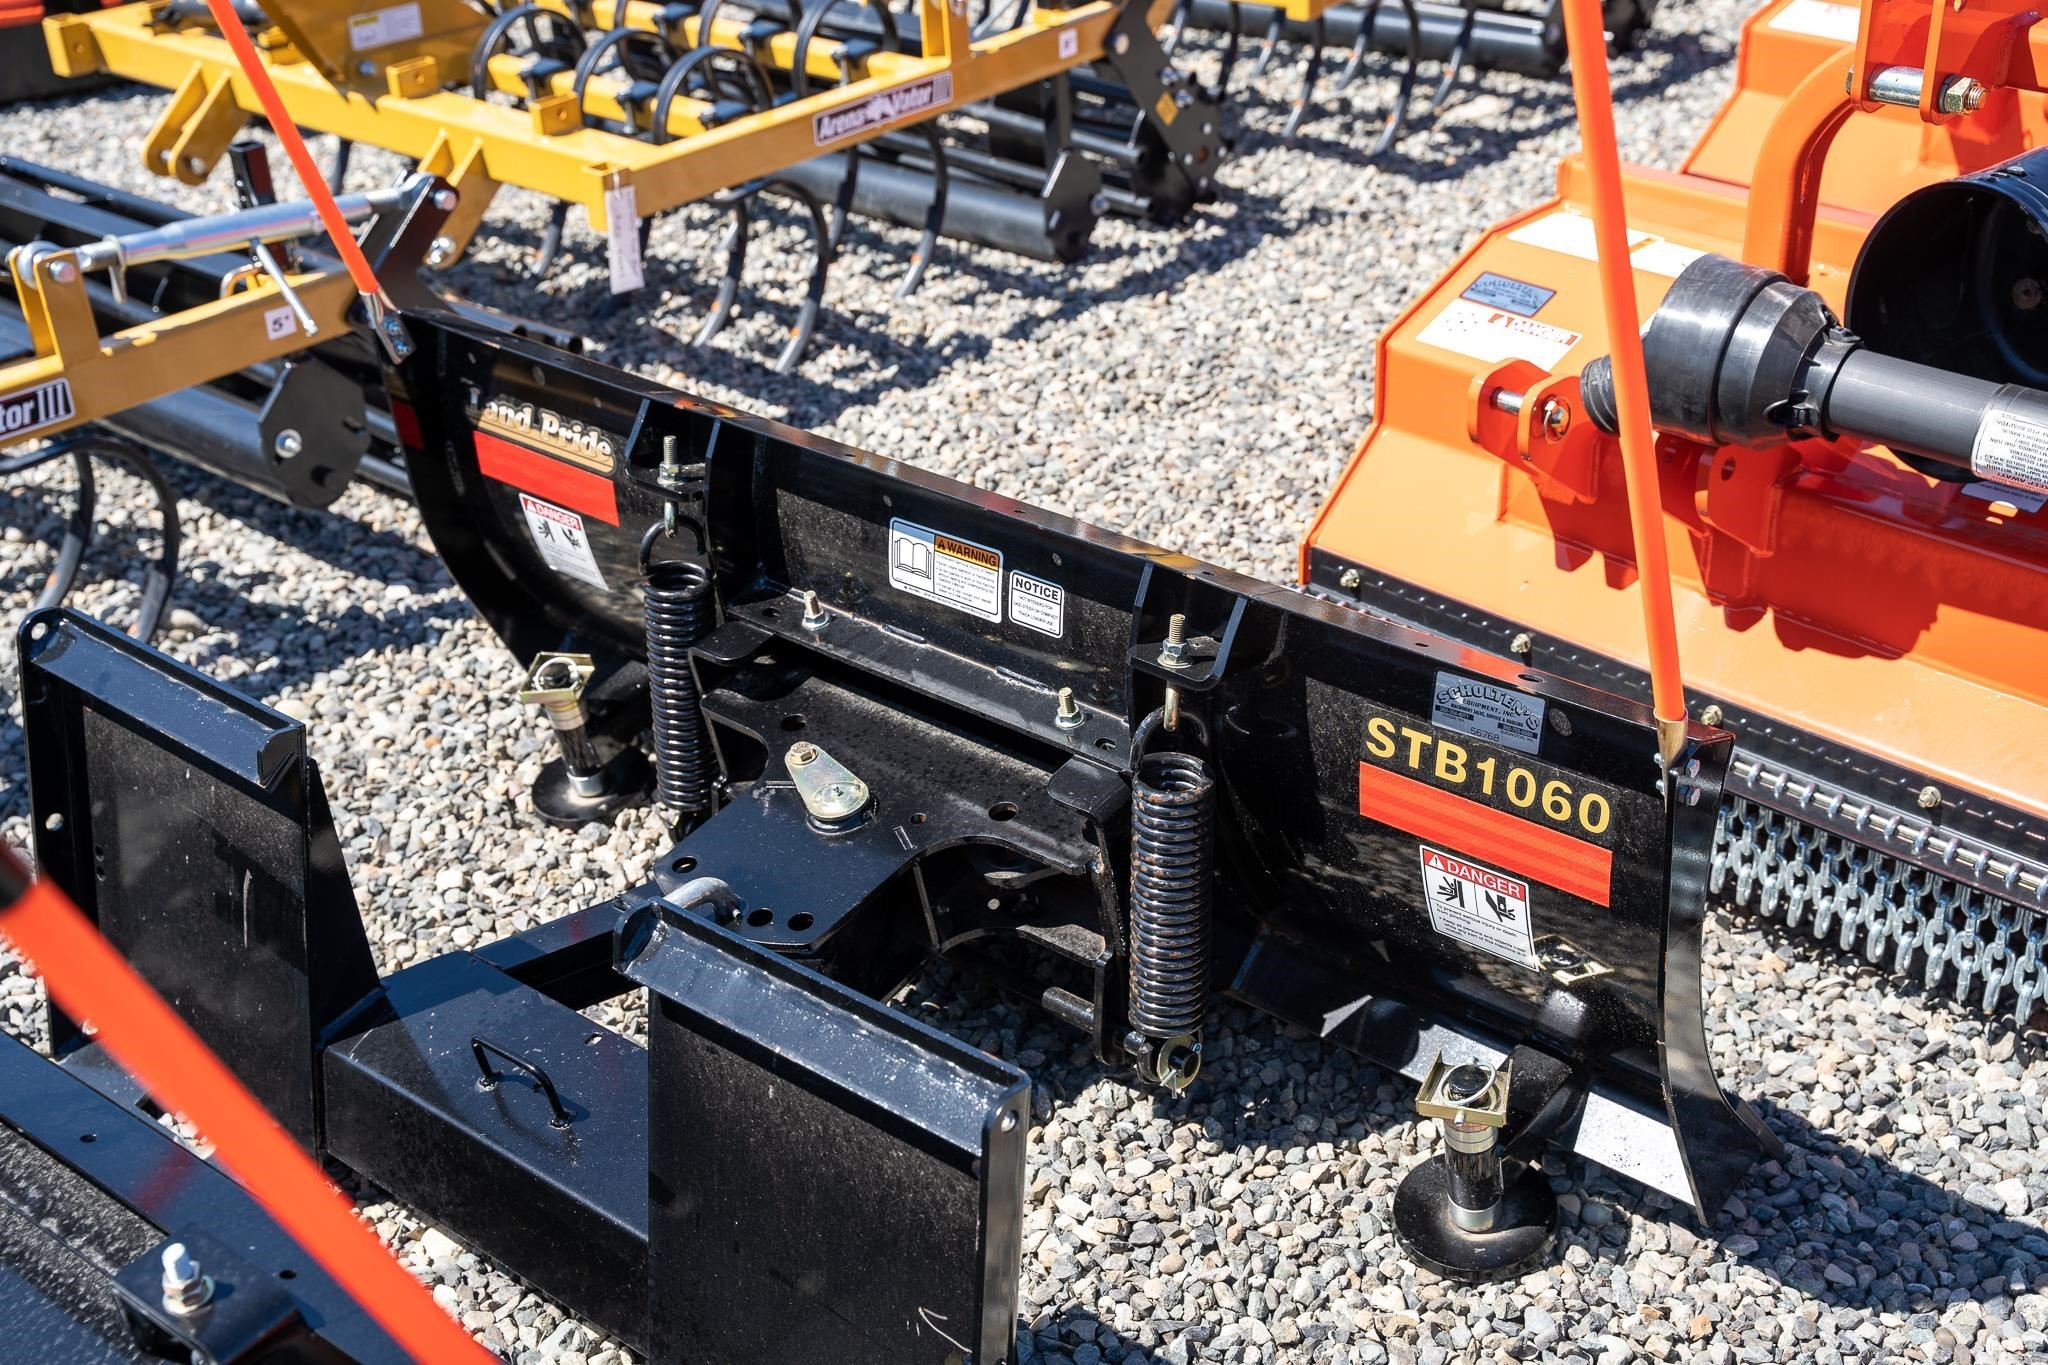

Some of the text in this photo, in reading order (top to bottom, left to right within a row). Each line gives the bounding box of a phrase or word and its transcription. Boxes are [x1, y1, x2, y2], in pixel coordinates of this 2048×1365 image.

[0, 399, 35, 434] tor
[540, 411, 613, 462] Pride
[947, 542, 997, 567] WARNING
[1015, 577, 1059, 601] NOTICE
[1437, 684, 1541, 731] SCHOLTEN'S
[1366, 717, 1611, 834] STB1060
[1447, 860, 1521, 898] DANGER
